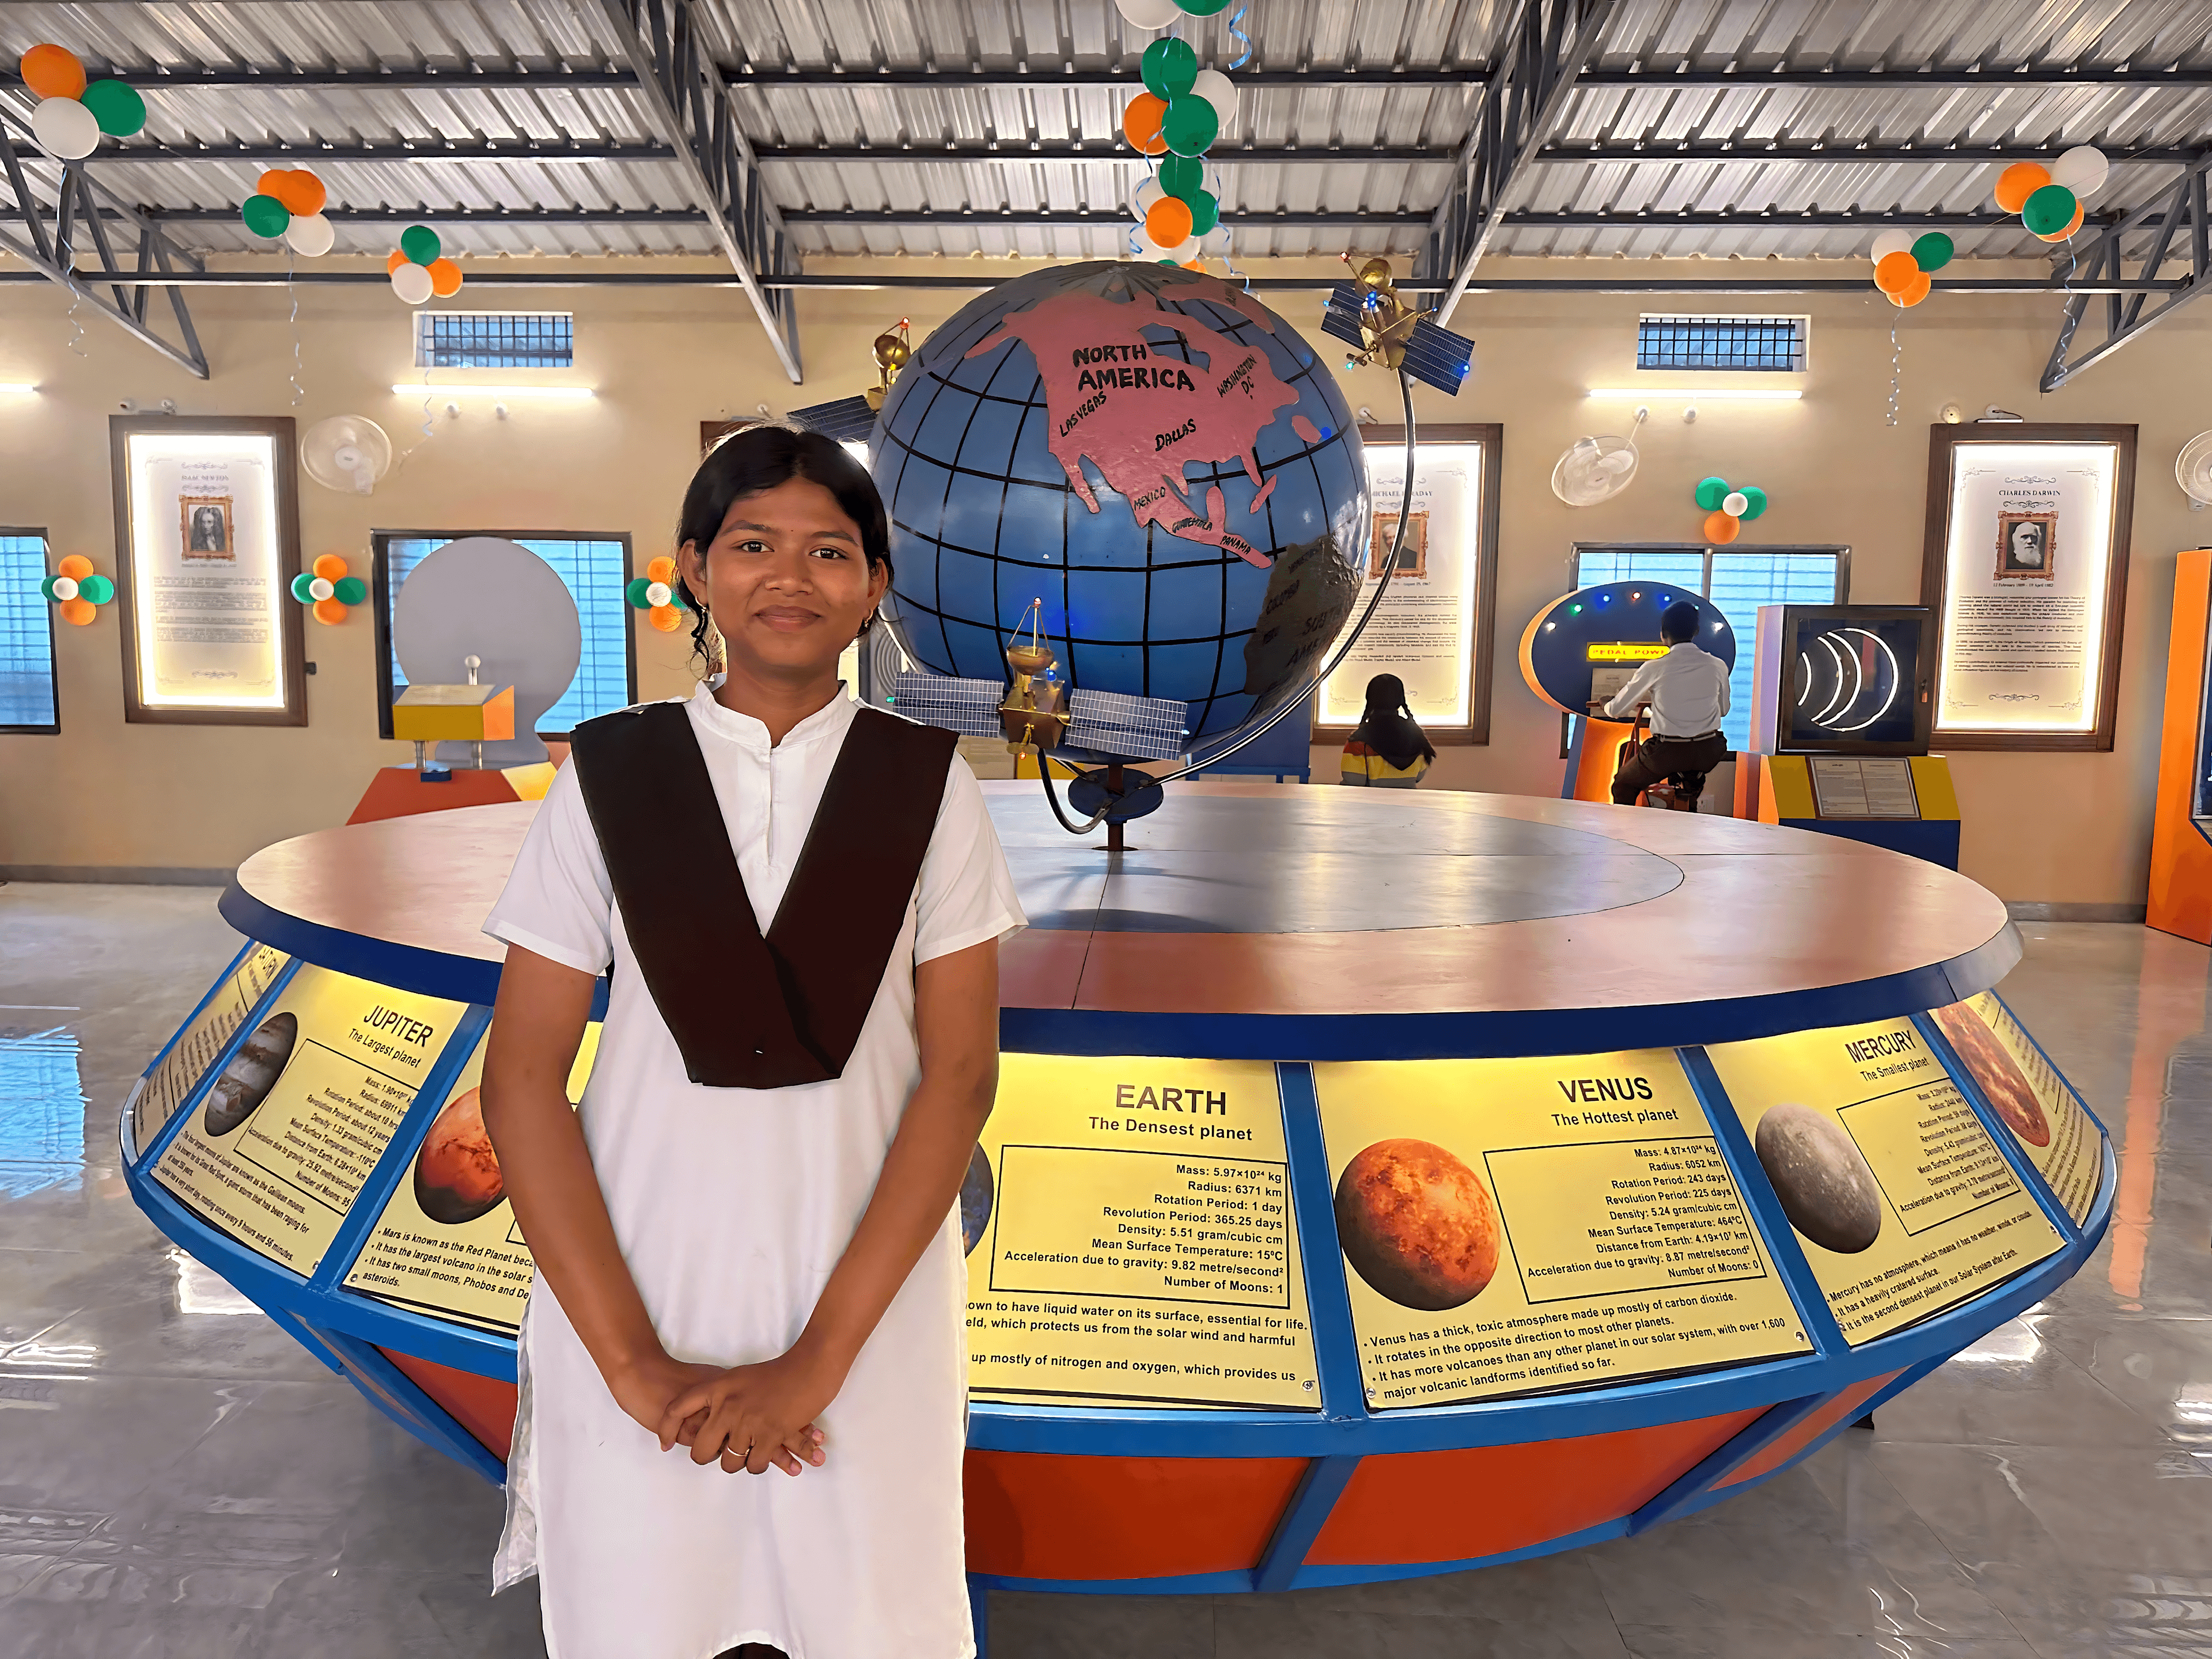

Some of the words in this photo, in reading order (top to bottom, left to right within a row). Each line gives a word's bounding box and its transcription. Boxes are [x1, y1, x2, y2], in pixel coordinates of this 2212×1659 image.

[1072, 344, 1147, 368] NORTH
[1078, 368, 1196, 392] AMERICA
[1217, 354, 1257, 398] WASHINGTON
[1059, 414, 1078, 438] LAS
[1075, 391, 1107, 420] VEGAS
[1155, 418, 1196, 452] DALLAS
[1134, 487, 1166, 511] MEXICO
[1220, 535, 1251, 555] PANAMA
[363, 1005, 434, 1048] JUPITER
[349, 1028, 363, 1043] The
[362, 1034, 395, 1056] Largest
[391, 1050, 422, 1069] planet
[1845, 1030, 1916, 1063] MERCURY
[1859, 1070, 1878, 1082] The
[1876, 1061, 1910, 1077] Smallest
[1907, 1056, 1930, 1072] planet
[1116, 1084, 1226, 1116] EARTH
[1557, 1077, 1653, 1103] VENUS
[1089, 1116, 1119, 1131] The
[1126, 1119, 1194, 1136] Densest
[1200, 1124, 1252, 1141] planet
[1551, 1113, 1580, 1126] The
[1582, 1110, 1635, 1124] Hottest
[1637, 1108, 1679, 1124] planet
[1176, 1164, 1209, 1176] Mass:
[1268, 1171, 1282, 1184] kg
[1188, 1180, 1232, 1194] Radius:
[1235, 1184, 1260, 1196] 6371
[1265, 1187, 1282, 1198] km
[1154, 1194, 1203, 1207] Rotation
[1207, 1198, 1248, 1210] Period:
[1252, 1201, 1257, 1211] 1
[1262, 1202, 1282, 1215] day
[1609, 1209, 1649, 1220] Density:
[1650, 1206, 1671, 1217] 5.24
[1672, 1202, 1722, 1217] gram/cubic
[1724, 1203, 1737, 1211] cm
[1103, 1206, 1165, 1220] Revolution
[1169, 1210, 1210, 1223] Period:
[1214, 1214, 1252, 1226] 365.25
[1255, 1217, 1282, 1230] days
[382, 1227, 402, 1239] Mars
[402, 1232, 411, 1241] is
[411, 1233, 438, 1247] known
[438, 1241, 450, 1249] as
[450, 1241, 465, 1252] the
[465, 1244, 484, 1256] Red
[483, 1248, 513, 1263] Planet
[1118, 1223, 1166, 1238] Density:
[1170, 1226, 1192, 1238] 5.51
[1197, 1230, 1262, 1243] gram/cubic
[1266, 1236, 1283, 1245] cm
[1596, 1243, 1639, 1253] Distance
[1640, 1239, 1664, 1249] from
[1664, 1235, 1694, 1247] Earth:
[1733, 1230, 1748, 1240] km
[1004, 1250, 1078, 1264] Acceleration
[1082, 1254, 1104, 1264] due
[1107, 1256, 1119, 1266] to
[1123, 1257, 1168, 1271] gravity:
[1172, 1259, 1196, 1271] 9.82
[1092, 1238, 1122, 1249] Mean
[1126, 1240, 1172, 1253] Surface
[1175, 1243, 1253, 1259] Temperature:
[375, 1241, 383, 1251] It
[382, 1243, 398, 1254] has
[398, 1247, 412, 1257] the
[412, 1249, 442, 1264] largest
[442, 1257, 475, 1271] volcano
[476, 1263, 486, 1273] in
[486, 1266, 502, 1277] the
[502, 1271, 527, 1282] solar
[362, 1272, 400, 1287] asteroids.
[369, 1256, 377, 1266] It
[376, 1257, 392, 1268] has
[391, 1261, 407, 1272] two
[407, 1266, 431, 1277] small
[430, 1271, 461, 1286] moons,
[463, 1276, 497, 1292] Phobos
[497, 1286, 517, 1296] and
[1164, 1275, 1211, 1289] Number
[1214, 1279, 1226, 1290] of
[1230, 1280, 1273, 1293] Moons:
[1277, 1284, 1282, 1294] 1
[1836, 1307, 1847, 1317] It
[1843, 1302, 1860, 1314] has
[1859, 1300, 1866, 1308] a
[1863, 1289, 1891, 1305] heavily
[1889, 1275, 1917, 1294] cratered
[1915, 1268, 1941, 1283] surface.
[1845, 1321, 1855, 1331] It
[1852, 1319, 1862, 1328] is
[1861, 1314, 1875, 1324] the
[1874, 1300, 1900, 1319] second
[1899, 1290, 1925, 1308] densest
[1923, 1282, 1944, 1299] planet
[1940, 1280, 1950, 1288] in
[1948, 1275, 1960, 1285] our
[1957, 1269, 1974, 1281] Solar
[1972, 1260, 1993, 1275] System
[1991, 1255, 2004, 1266] after
[2001, 1248, 2018, 1260] Earth.
[965, 1317, 987, 1330] eld,
[991, 1317, 1026, 1330] which
[1030, 1321, 1080, 1332] protects
[1084, 1324, 1098, 1333] us
[1102, 1323, 1130, 1335] from
[1133, 1325, 1153, 1336] the
[1156, 1327, 1187, 1338] solar
[1190, 1329, 1219, 1340] wind
[1223, 1332, 1245, 1343] and
[1249, 1332, 1296, 1346] harmful
[1374, 1354, 1384, 1365] It
[1385, 1350, 1426, 1363] rotates
[1428, 1346, 1441, 1357] in
[1442, 1344, 1461, 1355] the
[1464, 1336, 1512, 1353] opposite
[1514, 1330, 1562, 1344] direction
[1563, 1328, 1575, 1338] to
[1577, 1324, 1605, 1336] most
[1606, 1321, 1632, 1332] other
[1634, 1316, 1675, 1331] planets.
[1383, 1386, 1416, 1399] major
[1419, 1377, 1468, 1393] volcanic
[1469, 1370, 1527, 1386] landforms
[1528, 1361, 1580, 1377] identified
[1581, 1361, 1595, 1370] so
[1596, 1357, 1615, 1368] far.
